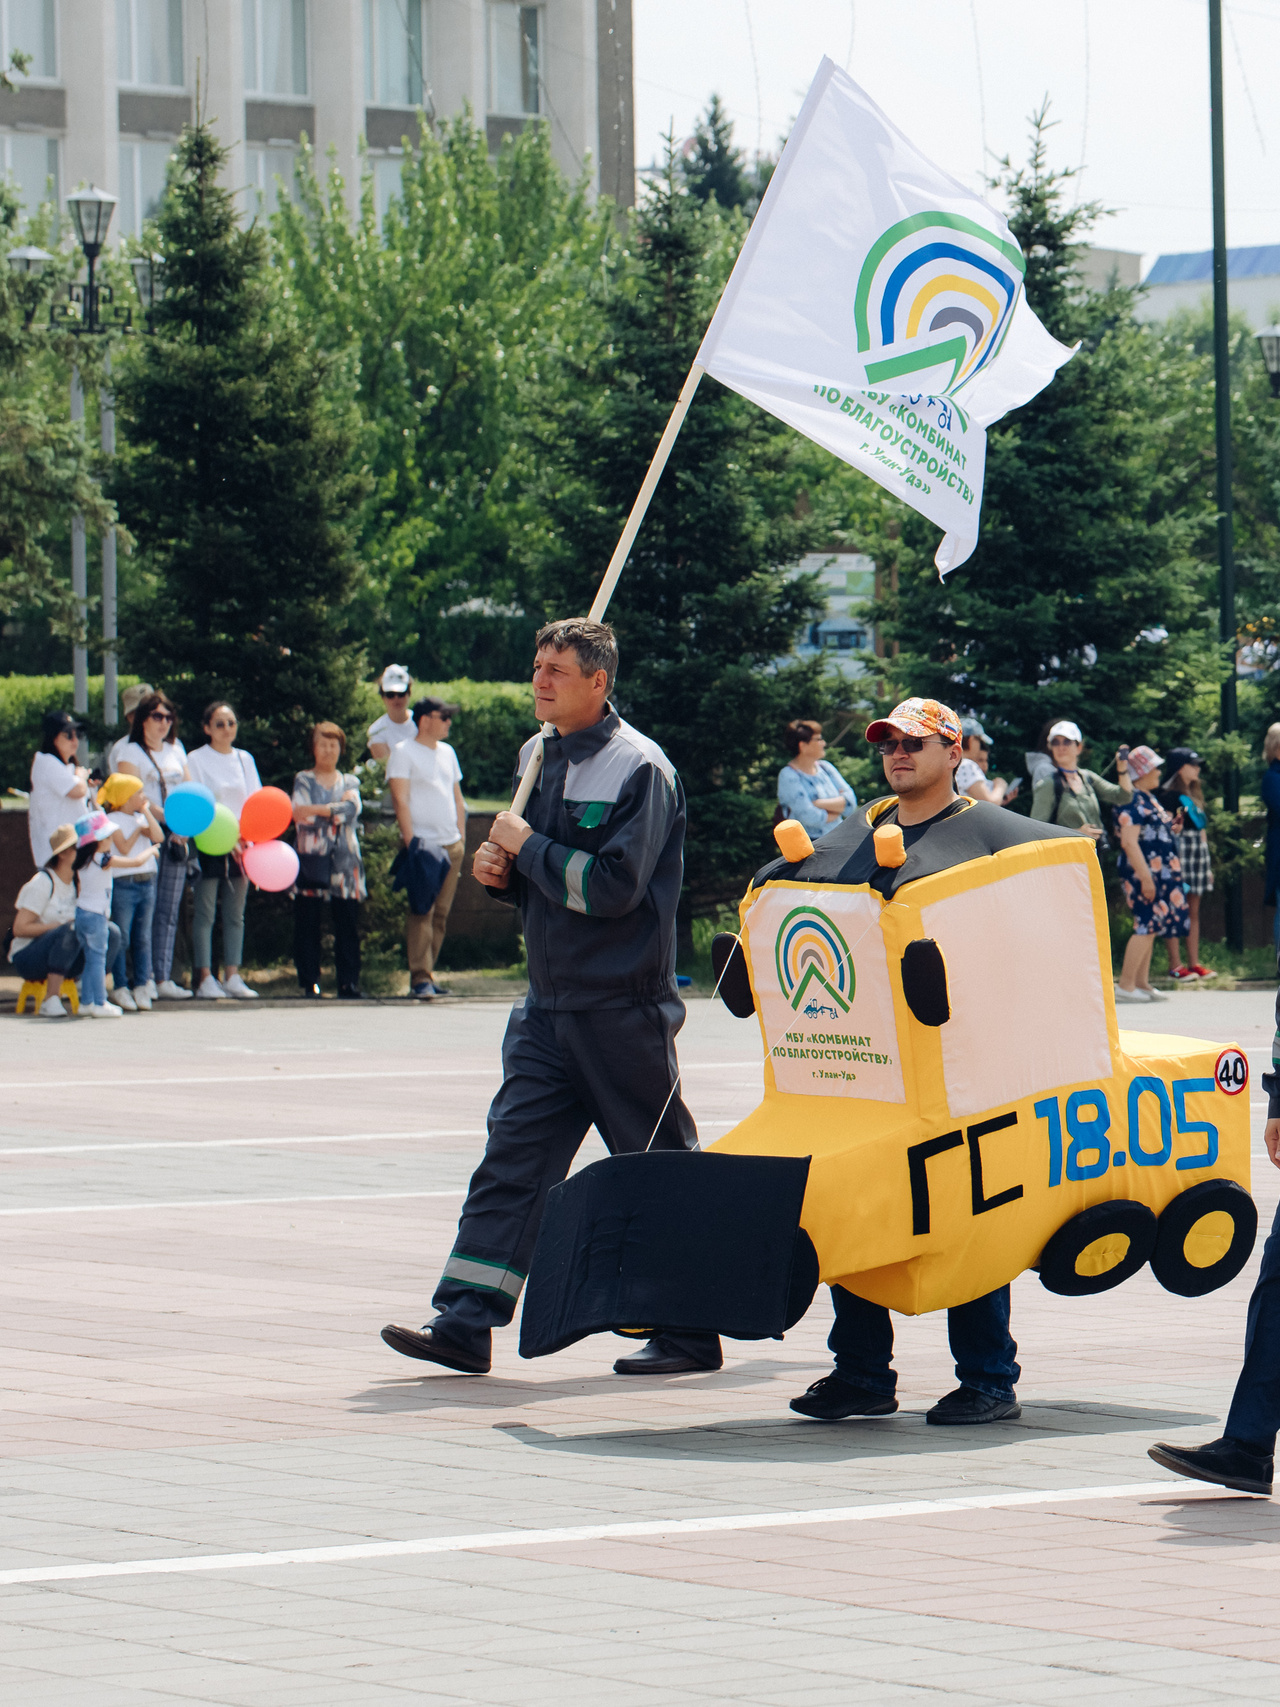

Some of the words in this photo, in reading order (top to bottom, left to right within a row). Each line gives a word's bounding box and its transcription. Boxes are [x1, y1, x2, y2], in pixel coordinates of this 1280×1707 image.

[840, 396, 975, 505] БЛАГОУСТРОЙСТВУ
[861, 390, 891, 406] БУ
[889, 404, 967, 470] «КОМБИНАТ
[870, 447, 932, 495] Улан-Удэ»
[772, 1046, 787, 1057] ПО
[786, 1033, 804, 1043] МБУ
[807, 1034, 871, 1047] «КОМБИНАТ
[1219, 1057, 1246, 1087] 40
[907, 1111, 1024, 1236] ГС
[1034, 1076, 1219, 1188] 18.05
